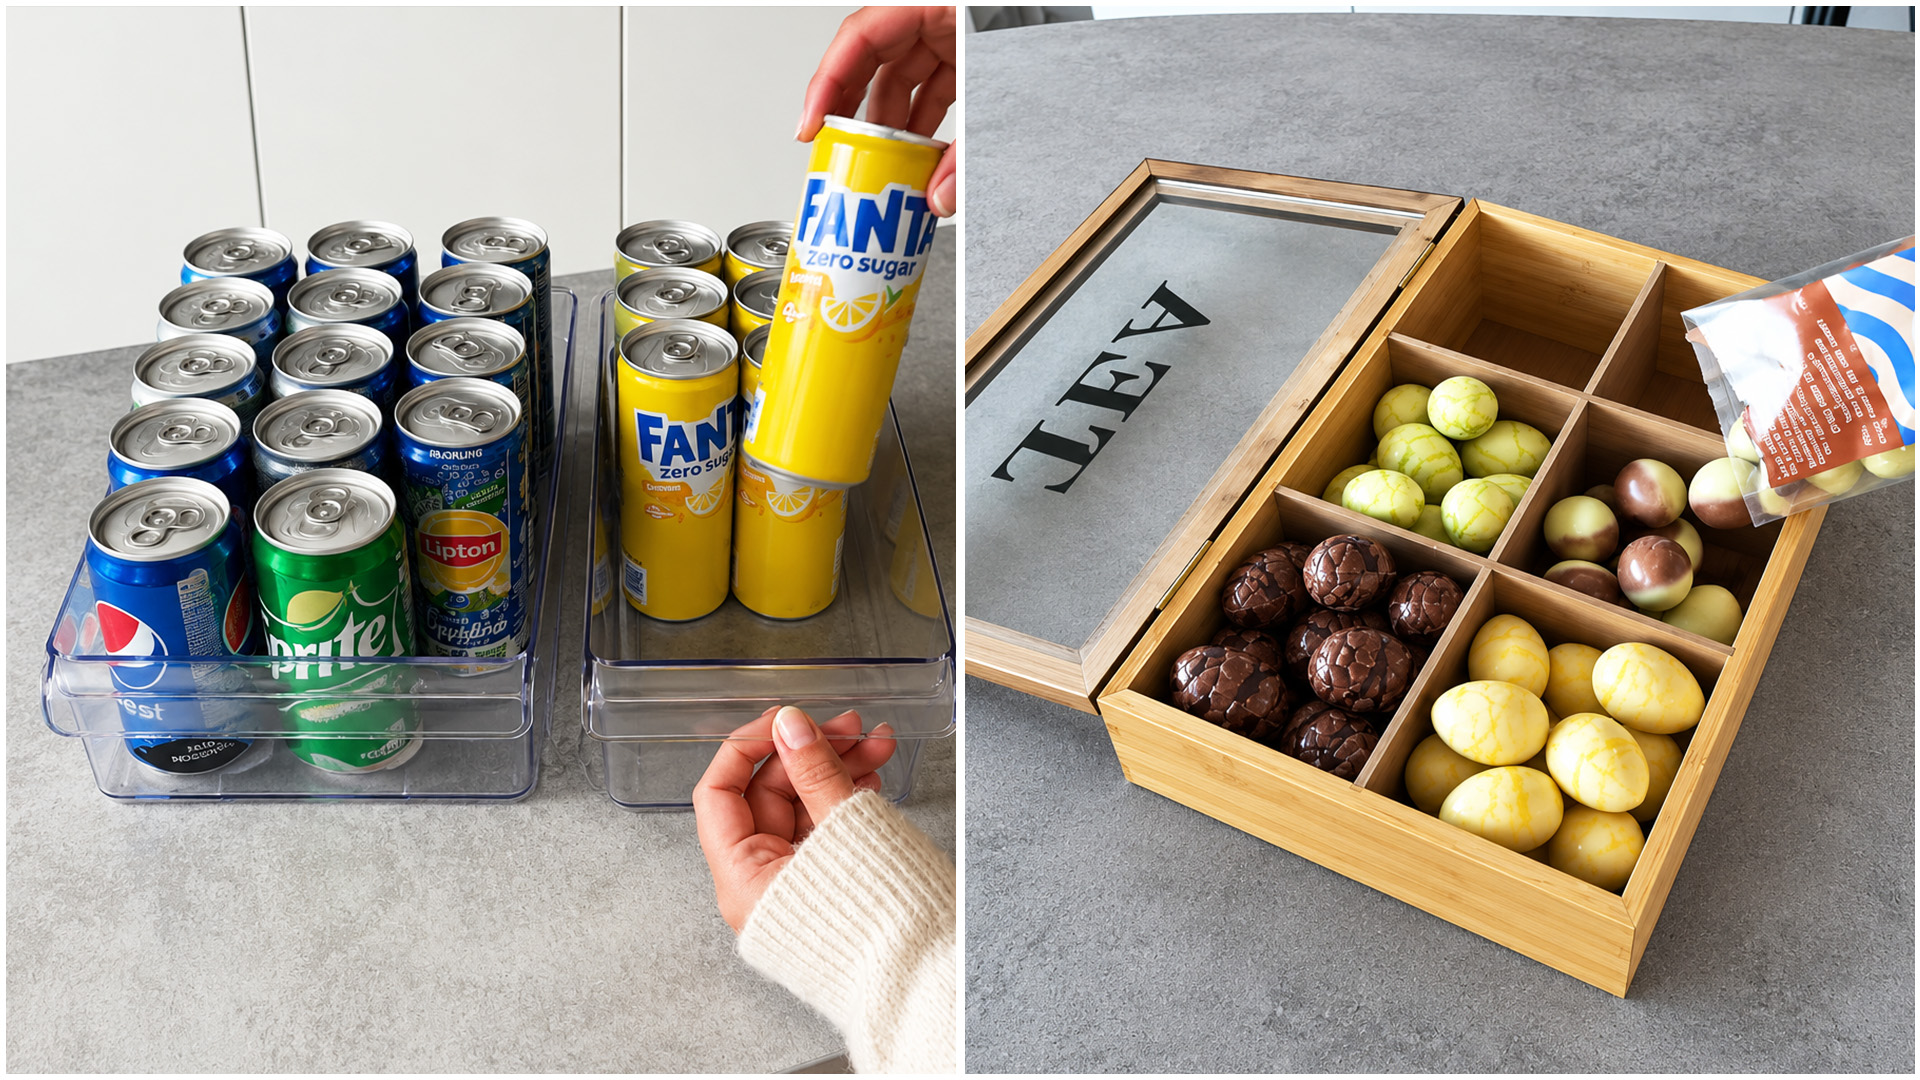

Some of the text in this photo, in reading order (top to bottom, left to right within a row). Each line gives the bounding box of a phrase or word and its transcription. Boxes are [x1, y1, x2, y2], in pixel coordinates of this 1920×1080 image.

[797, 178, 938, 257] FANTA
[806, 250, 917, 281] zero sugar
[660, 465, 702, 479] zero
[425, 538, 496, 561] Lipton
[261, 609, 387, 680] prite
[116, 698, 165, 720] est
